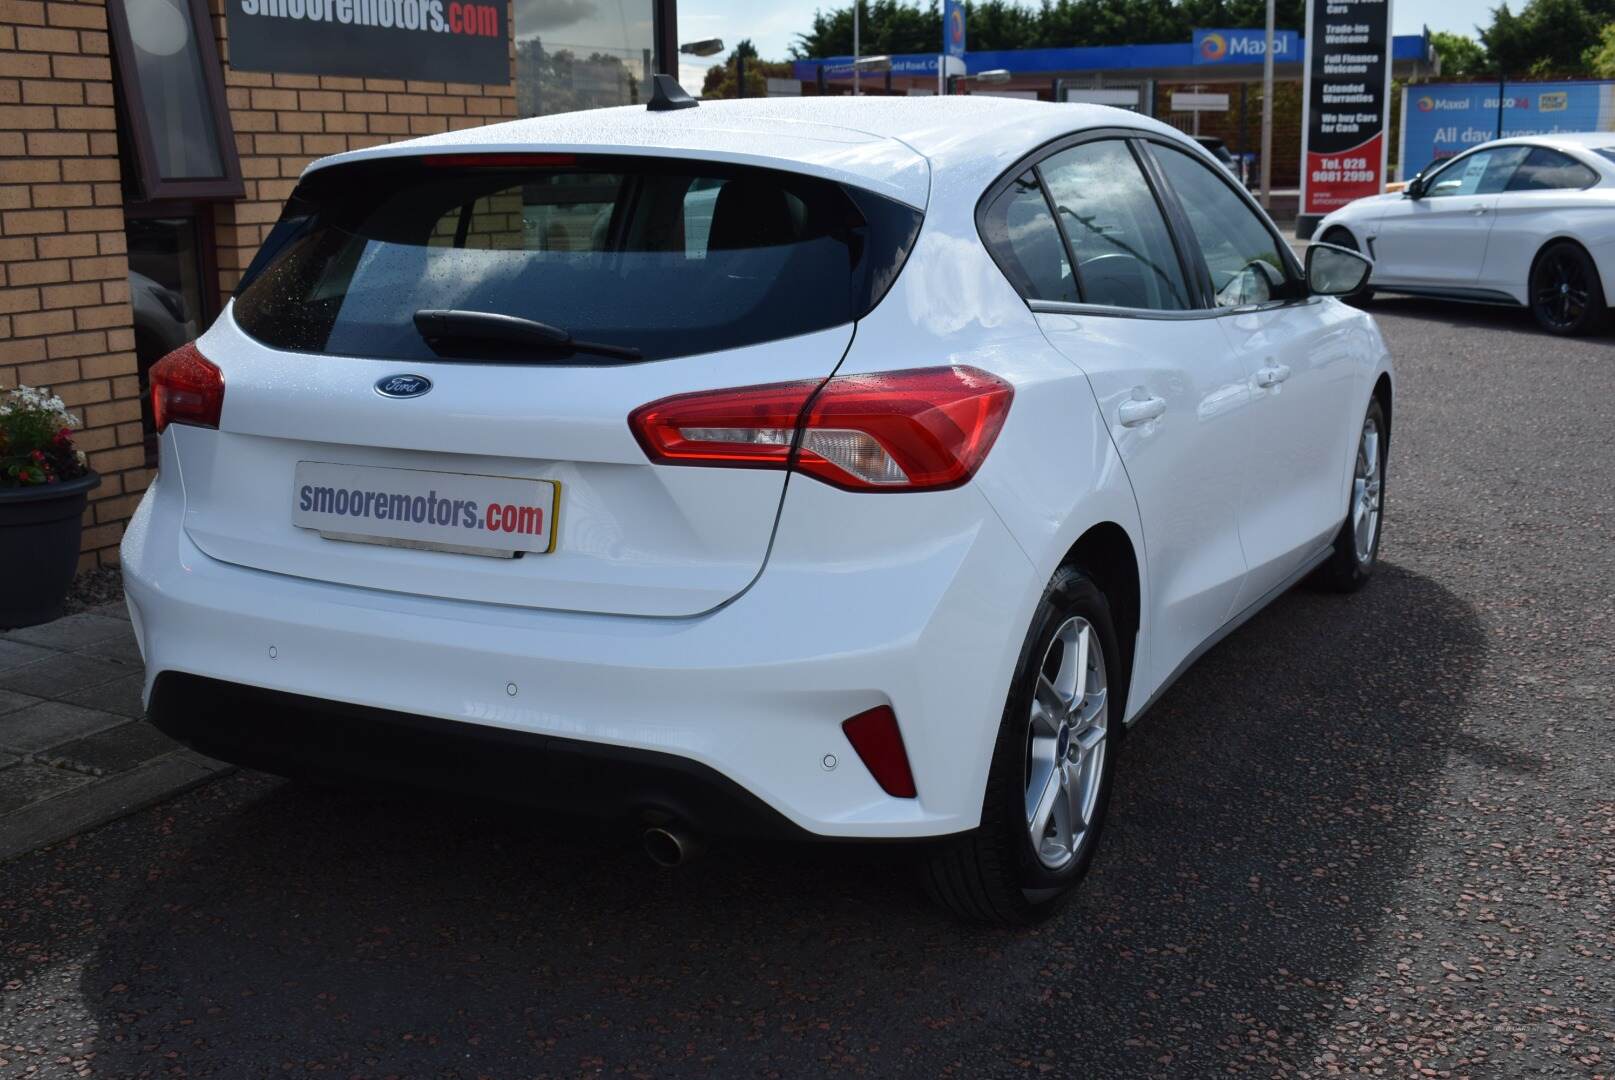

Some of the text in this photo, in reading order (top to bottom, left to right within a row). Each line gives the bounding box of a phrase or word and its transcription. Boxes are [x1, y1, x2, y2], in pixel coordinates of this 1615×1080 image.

[1326, 4, 1349, 15] Cars
[1325, 34, 1370, 44] Welcome
[1230, 34, 1288, 56] Maxol
[1324, 53, 1379, 64] Full Finance
[1323, 64, 1368, 74] Welcome
[1322, 83, 1366, 94] Extended
[1322, 93, 1374, 104] Warranties
[1434, 97, 1469, 110] Maxol
[1321, 113, 1378, 124] We buy Cars
[1321, 123, 1360, 133] for Cash
[1433, 127, 1457, 144] All
[1461, 126, 1492, 144] day
[1343, 158, 1367, 170] 028
[1311, 170, 1341, 182] 9081
[385, 377, 420, 392] Ford
[299, 484, 543, 536] smooremotors.com
